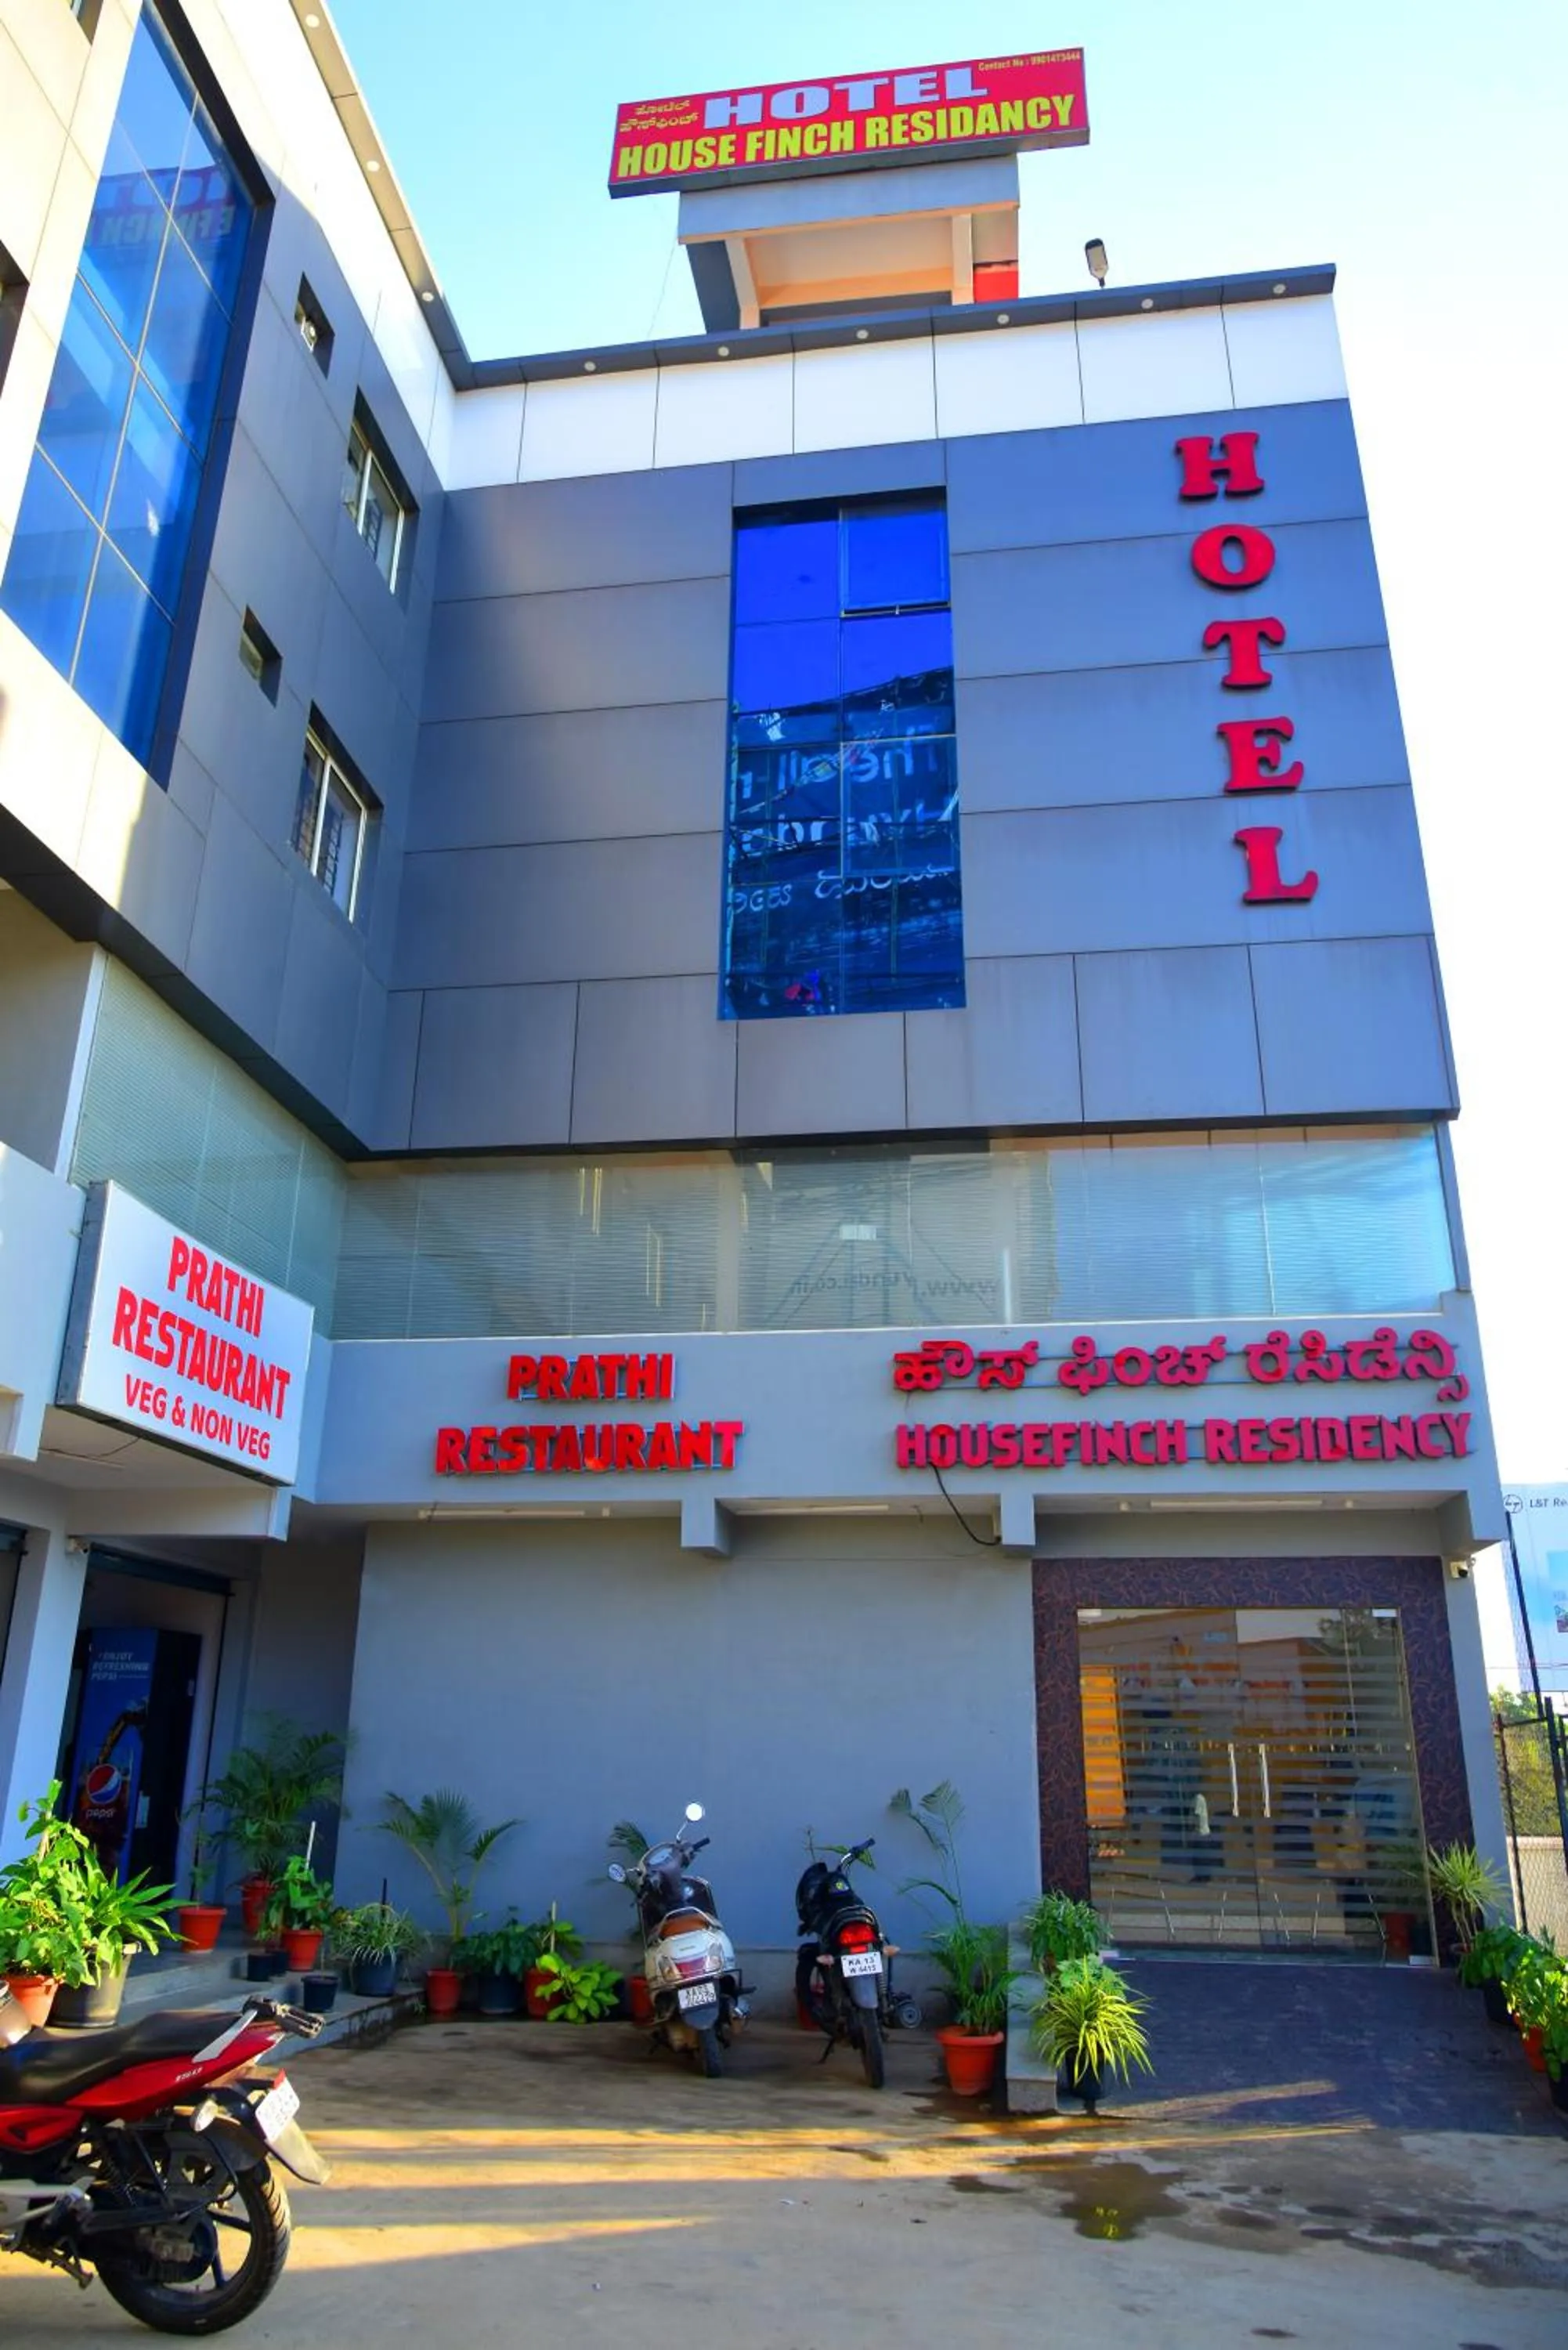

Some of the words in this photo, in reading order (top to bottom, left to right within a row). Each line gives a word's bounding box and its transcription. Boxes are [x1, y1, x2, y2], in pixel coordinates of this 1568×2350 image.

[703, 67, 988, 129] HOTEL
[979, 61, 1011, 70] Contact
[616, 134, 736, 179] HOUSE
[745, 120, 854, 163] FINCH
[865, 94, 1076, 149] RESIDANCY
[1175, 432, 1319, 904] HOTEL
[167, 1236, 265, 1338] PRATHI
[112, 1286, 291, 1419] RESTAURANT
[507, 1354, 675, 1399] PRATHI
[894, 1340, 1039, 1391] ಹೌಸ್
[1058, 1335, 1227, 1396] ಫಿಂಚ್
[1244, 1327, 1470, 1401] ರೆಸಿಡೆನ್ಸಿ
[125, 1373, 168, 1420] VEG
[171, 1395, 186, 1428] &
[190, 1402, 233, 1447] NON
[237, 1422, 271, 1460] VEG
[435, 1421, 744, 1474] RESTAURANT
[896, 1419, 1189, 1470] HOUSEFINCH
[1205, 1412, 1472, 1464] RESIDENCY
[85, 1807, 117, 1820] pepsi
